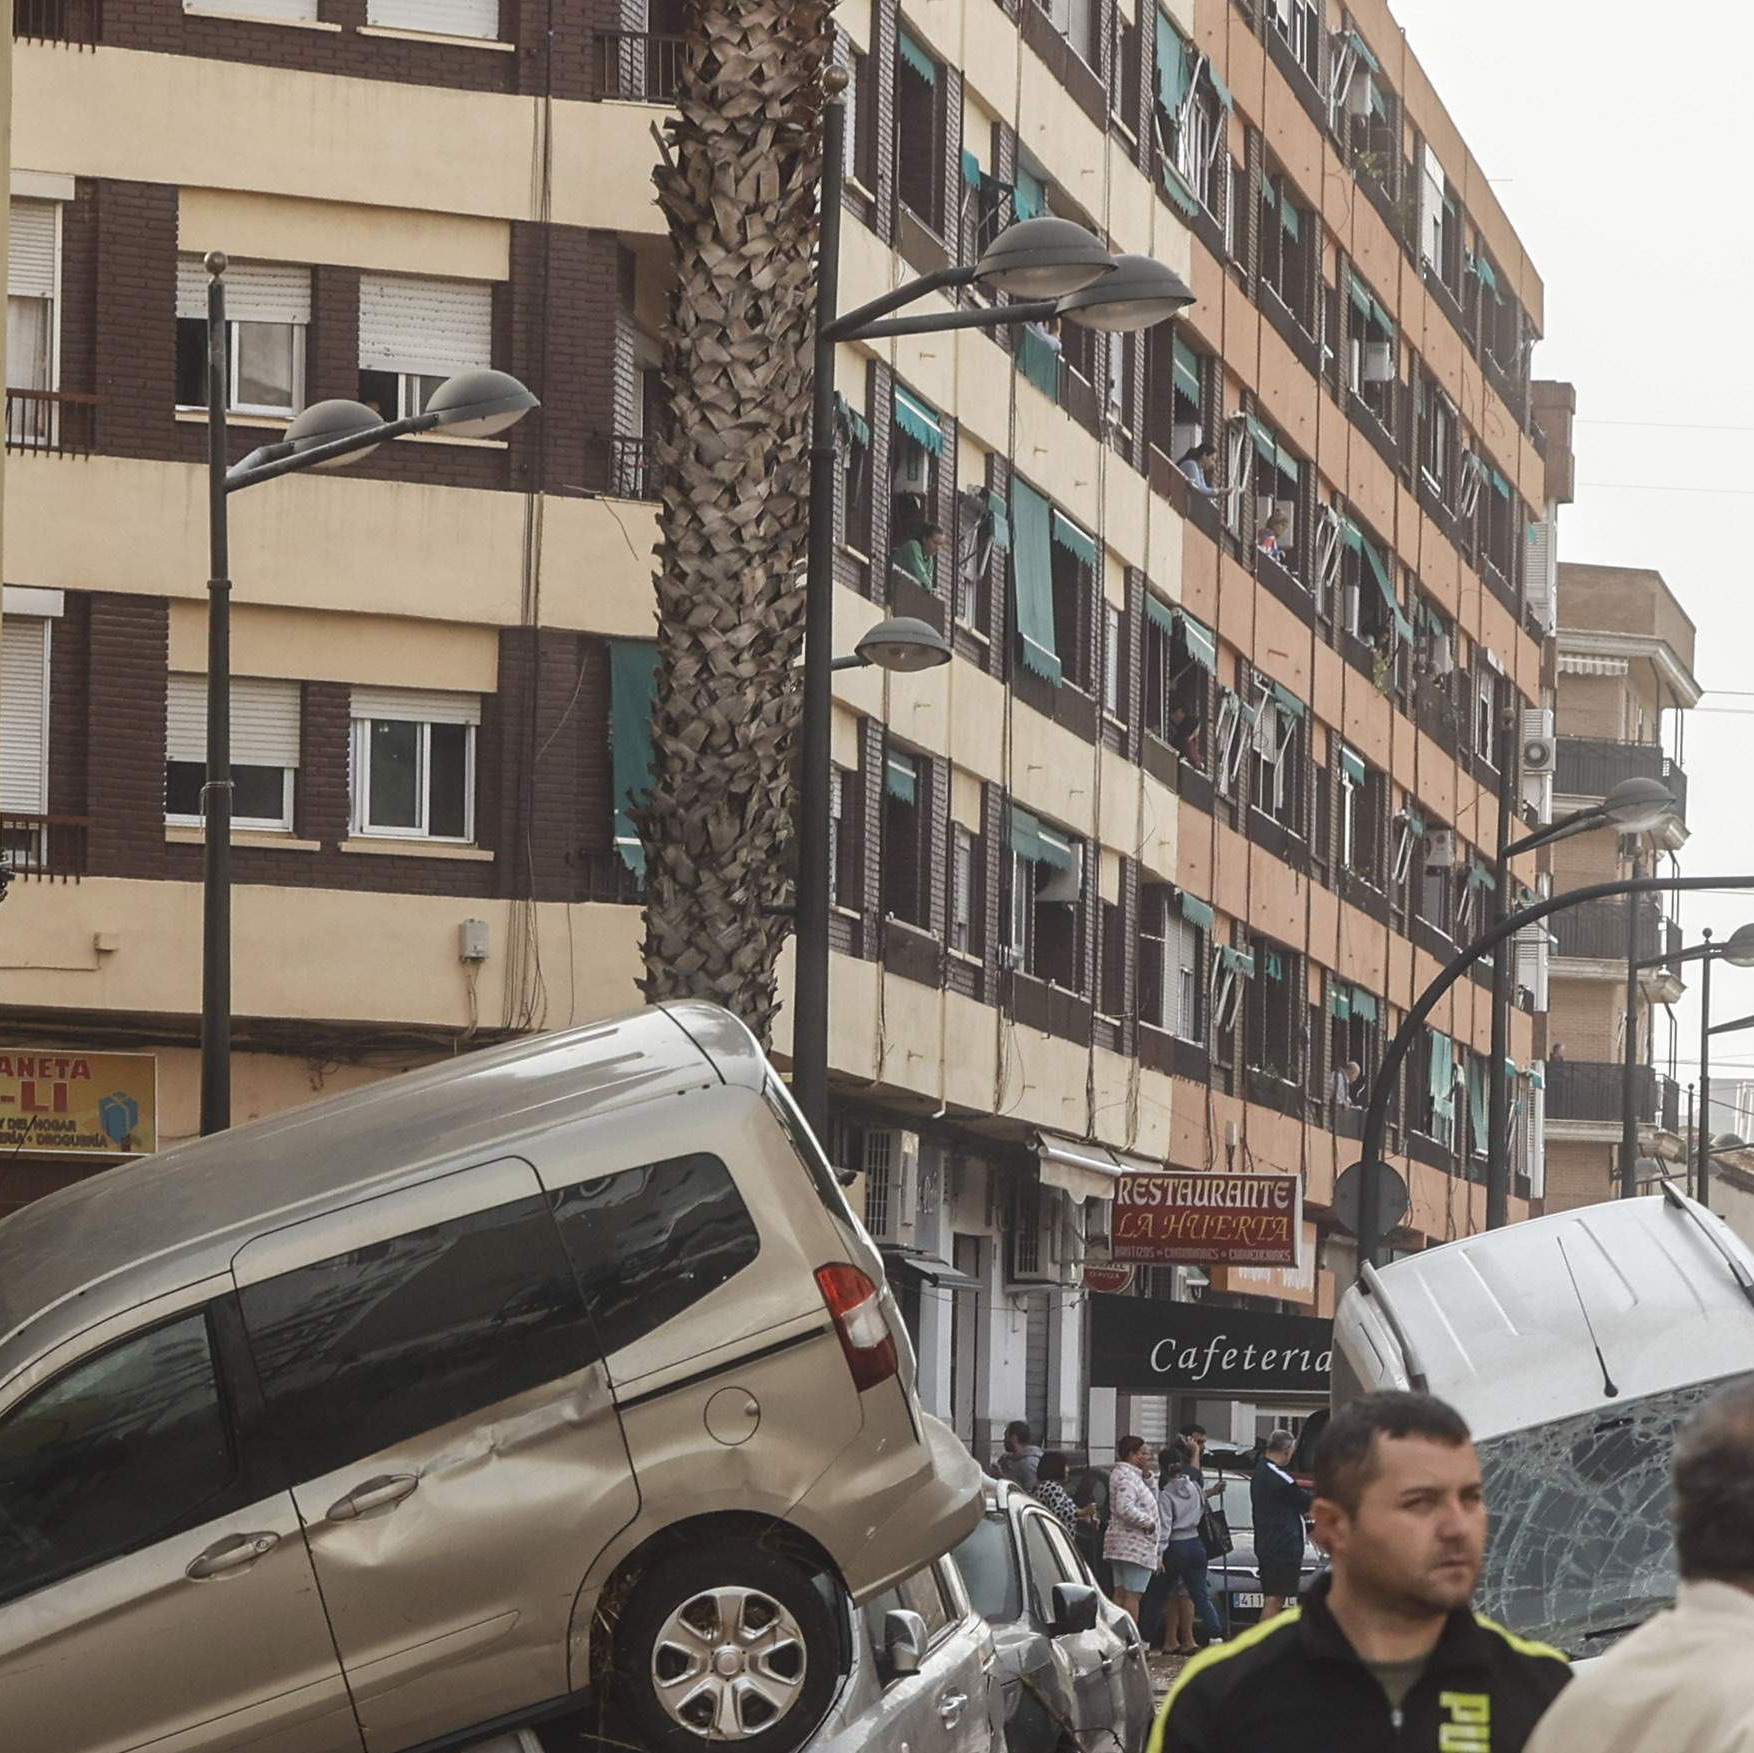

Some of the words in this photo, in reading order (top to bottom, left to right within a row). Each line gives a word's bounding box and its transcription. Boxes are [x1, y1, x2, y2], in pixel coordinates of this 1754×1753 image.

[1116, 1177, 1291, 1209] RESTAURANTE
[1115, 1212, 1154, 1239] LA
[1160, 1210, 1290, 1246] HUERTA
